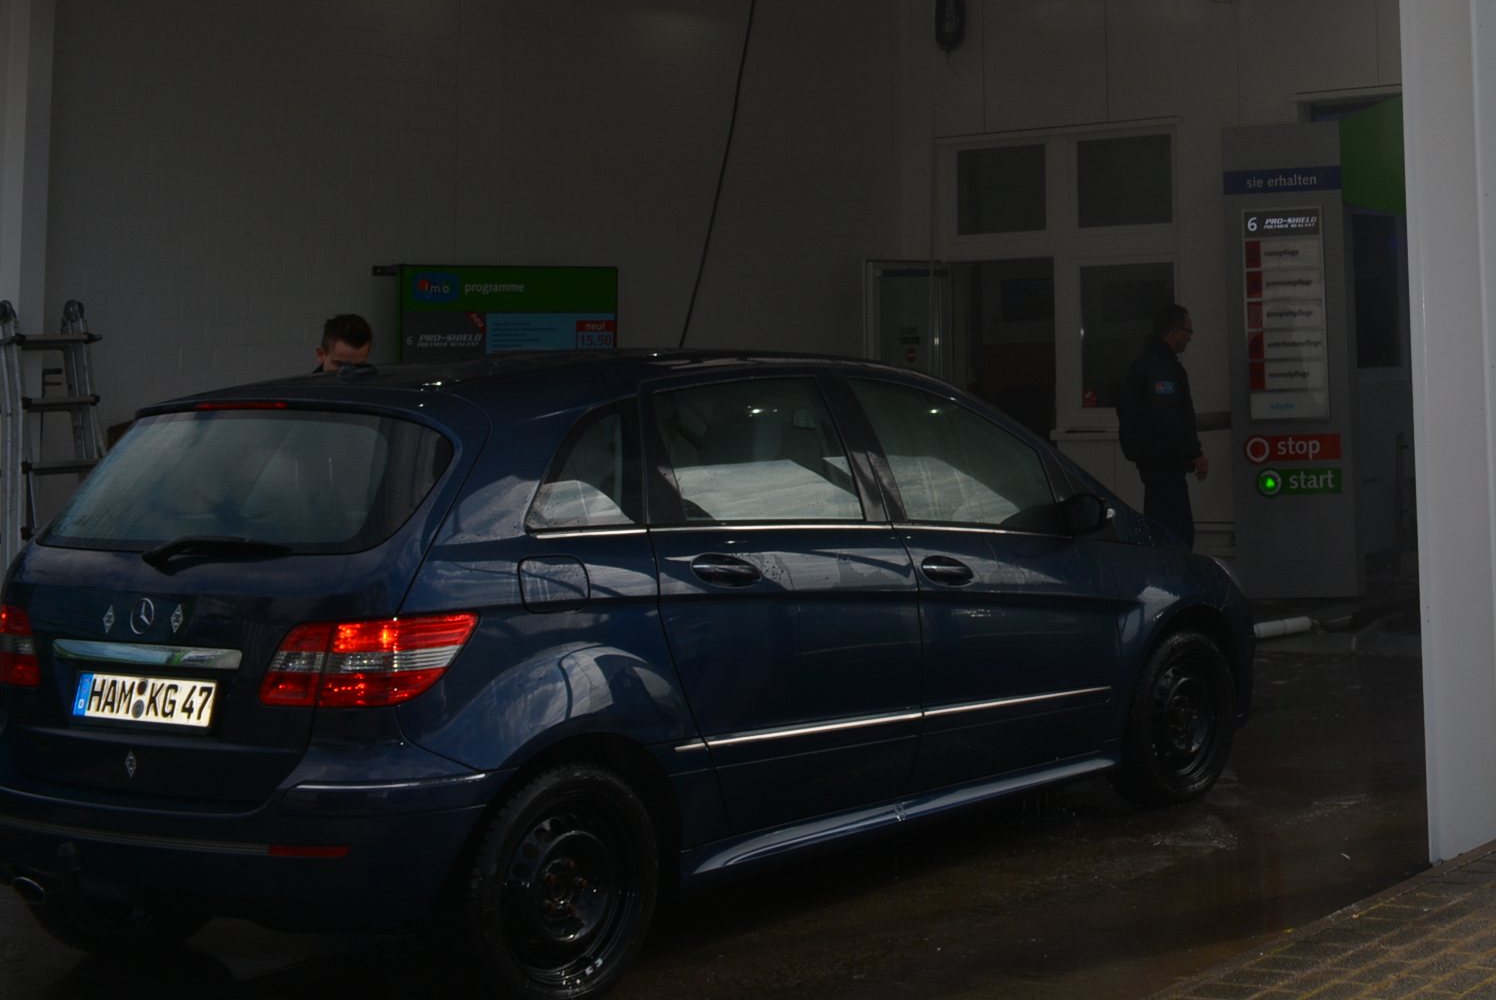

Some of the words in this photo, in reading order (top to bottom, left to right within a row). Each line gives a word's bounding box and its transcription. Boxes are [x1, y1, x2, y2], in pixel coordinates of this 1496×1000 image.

[1246, 176, 1264, 189] sie
[1266, 173, 1317, 188] erhalten
[1247, 216, 1258, 232] 6
[1264, 215, 1318, 225] PRO-SHIELD
[464, 283, 525, 295] programme
[470, 312, 485, 328] neu
[585, 321, 606, 331] neu!
[405, 336, 413, 346] 6
[418, 333, 483, 342] PRO-SHIELD
[579, 334, 612, 347] 15,50
[1277, 436, 1321, 460] stop
[1289, 469, 1335, 489] start
[87, 678, 136, 715] HAM
[146, 682, 178, 719] KG
[181, 685, 213, 721] 47
